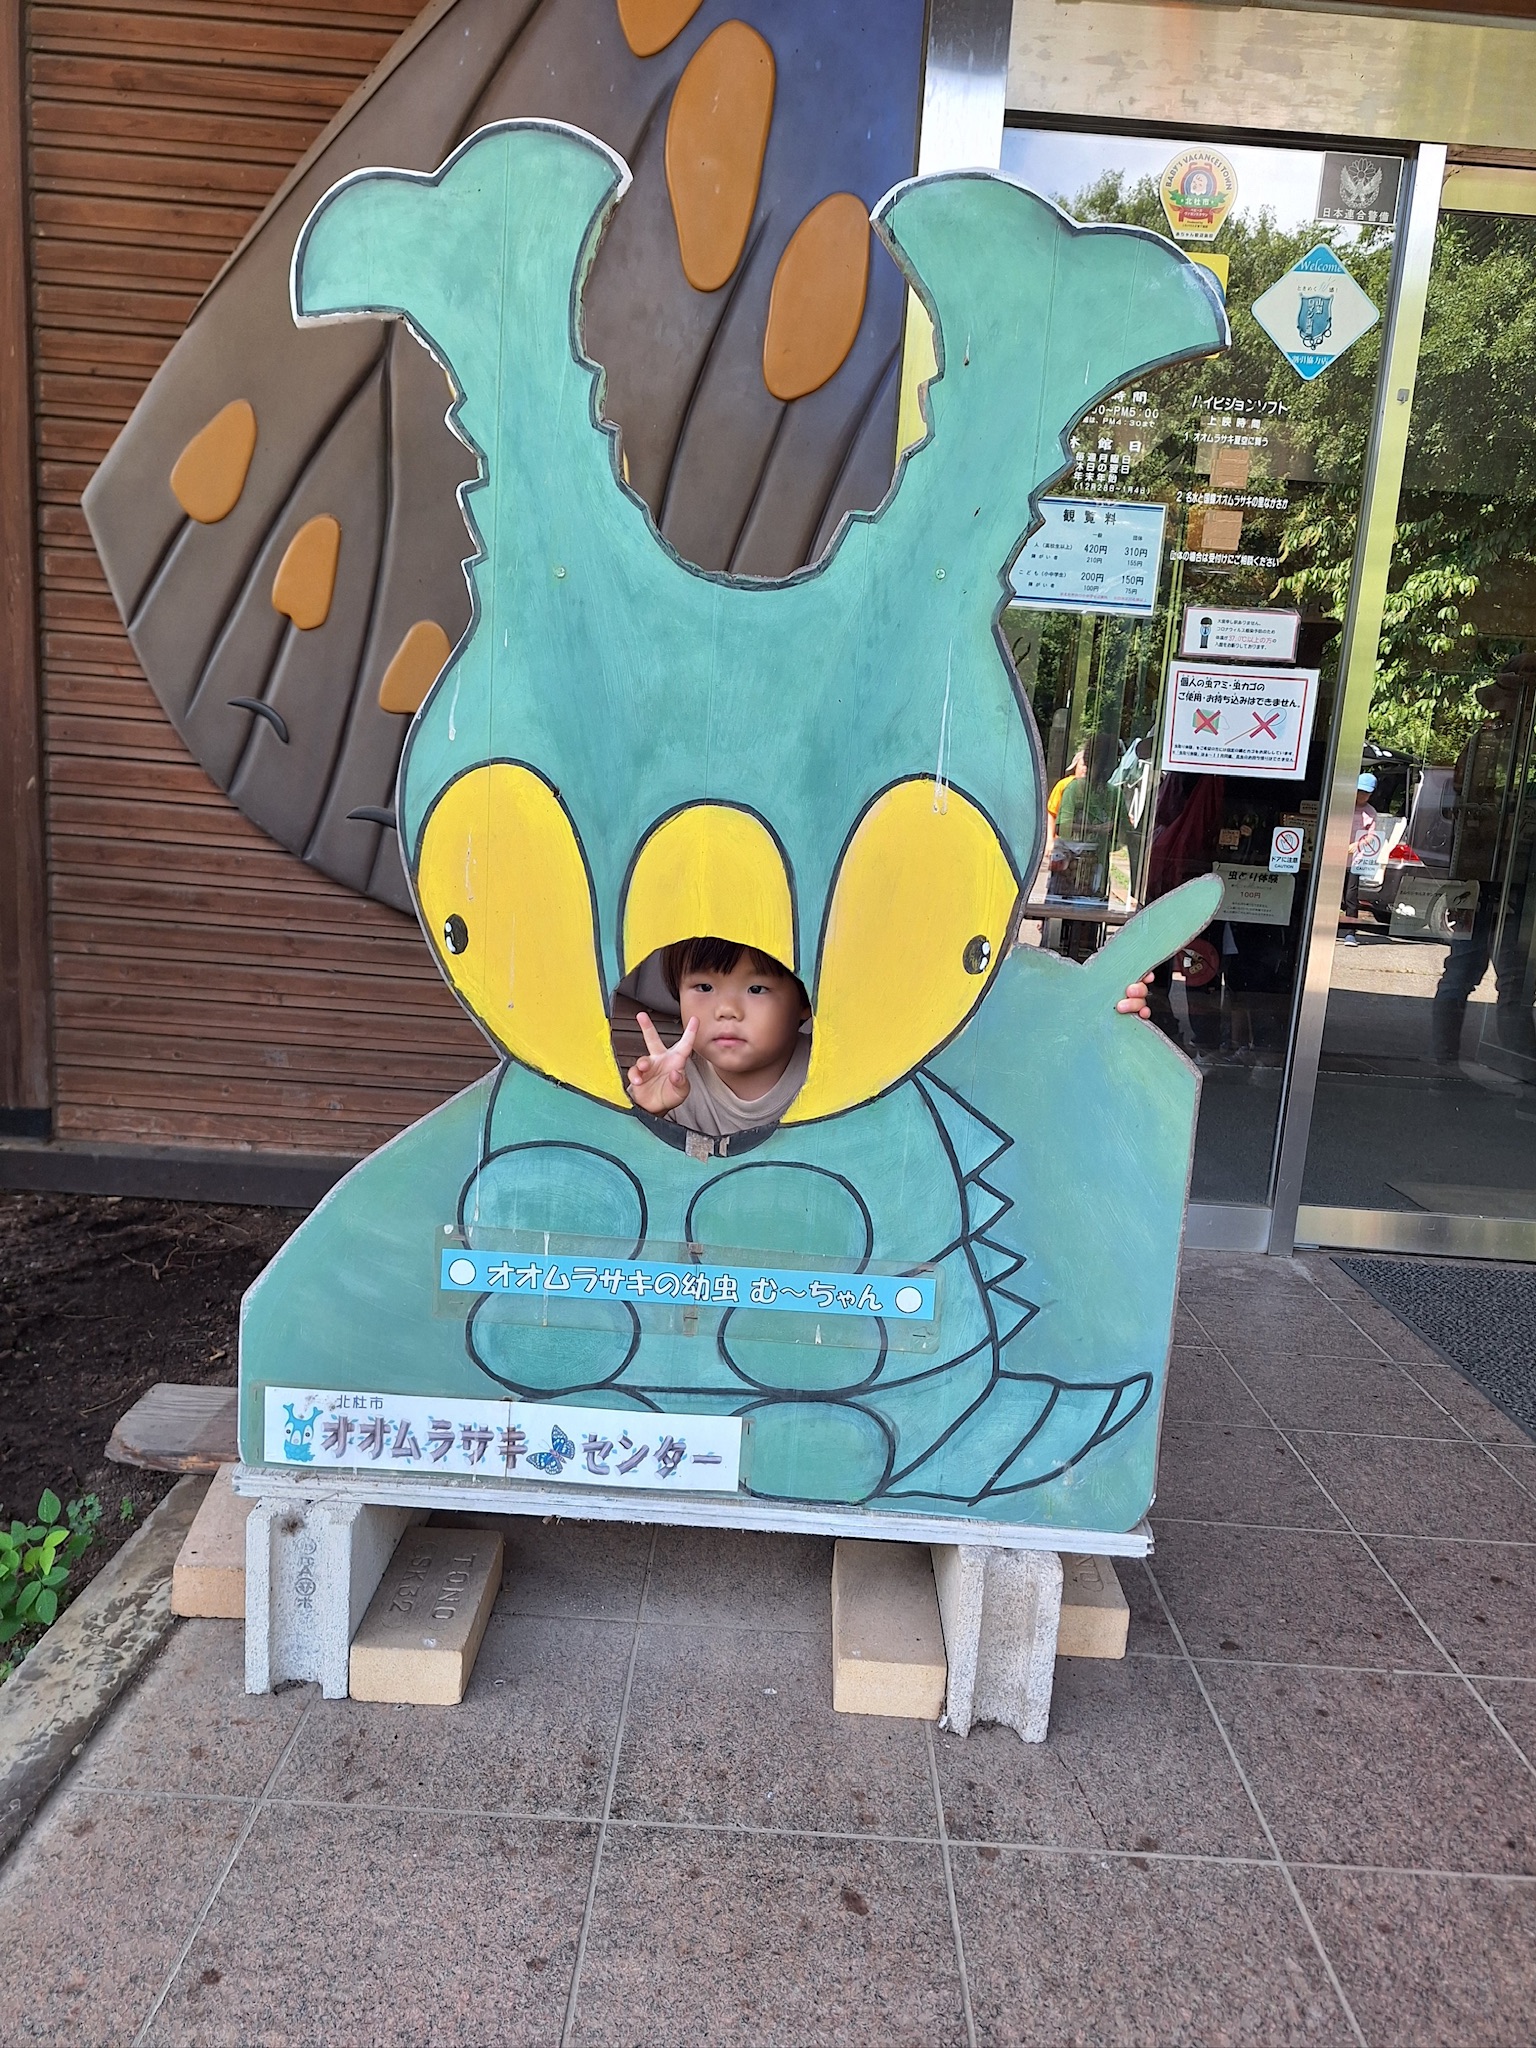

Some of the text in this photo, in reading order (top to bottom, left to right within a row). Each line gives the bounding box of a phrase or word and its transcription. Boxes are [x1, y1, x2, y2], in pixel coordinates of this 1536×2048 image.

[1166, 153, 1233, 191] BABY'S VACANCES TOWN
[1185, 198, 1210, 206] 北杜市
[1323, 207, 1390, 223] 日本連合警備
[1300, 257, 1342, 273] Welcome
[1191, 395, 1289, 415] ハイビジョンソフト
[1207, 415, 1262, 430] 上映時間
[1075, 451, 1131, 465] 毎週月曜日
[1073, 473, 1118, 484] 年末年始
[1062, 508, 1117, 525] 観覧料
[1084, 544, 1108, 555] 420円
[1124, 546, 1148, 558] 310円
[1086, 556, 1103, 564] 210円
[1080, 571, 1104, 583] 200円
[1121, 575, 1145, 586] 150円
[1125, 587, 1138, 595] 75円
[1180, 677, 1266, 692] 個人の虫アミ・虫カゴの
[1178, 692, 1301, 708] ご使用・お持ち込みはできません。
[1271, 856, 1298, 864] ドアに注意
[1228, 870, 1279, 884] 虫とり体験
[1240, 891, 1261, 899] 100円
[487, 1261, 739, 1304] オオムラサキの幼虫
[336, 1394, 384, 1410] 北杜市
[320, 1413, 724, 1480] オオムラサキ センター
[432, 1553, 477, 1620] TONO
